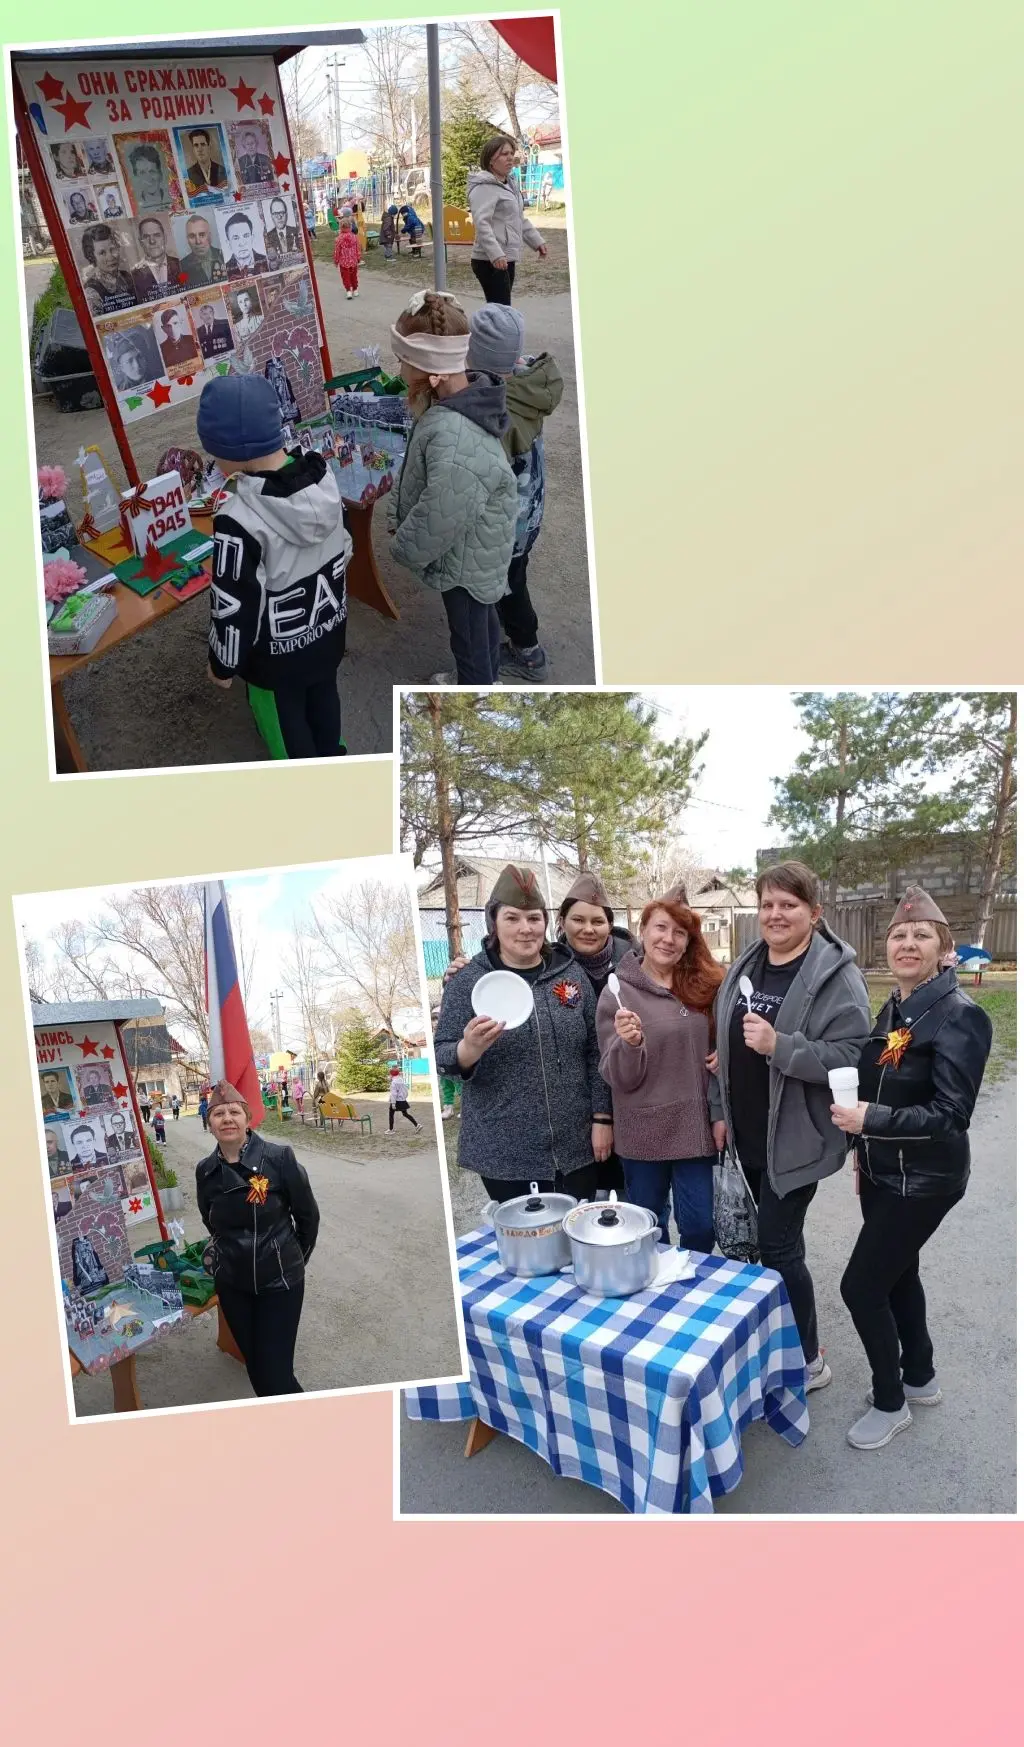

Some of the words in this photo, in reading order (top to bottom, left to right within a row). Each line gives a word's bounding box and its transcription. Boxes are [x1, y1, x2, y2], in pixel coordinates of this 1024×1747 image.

[77, 71, 119, 96] ОНИ
[124, 67, 227, 94] СРАЖАЛИСЬ
[106, 99, 133, 122] ЗА
[140, 93, 214, 121] РОДИНУ!
[151, 487, 184, 518] 1941
[147, 509, 187, 542] 1945
[270, 624, 323, 656] EMPORIO
